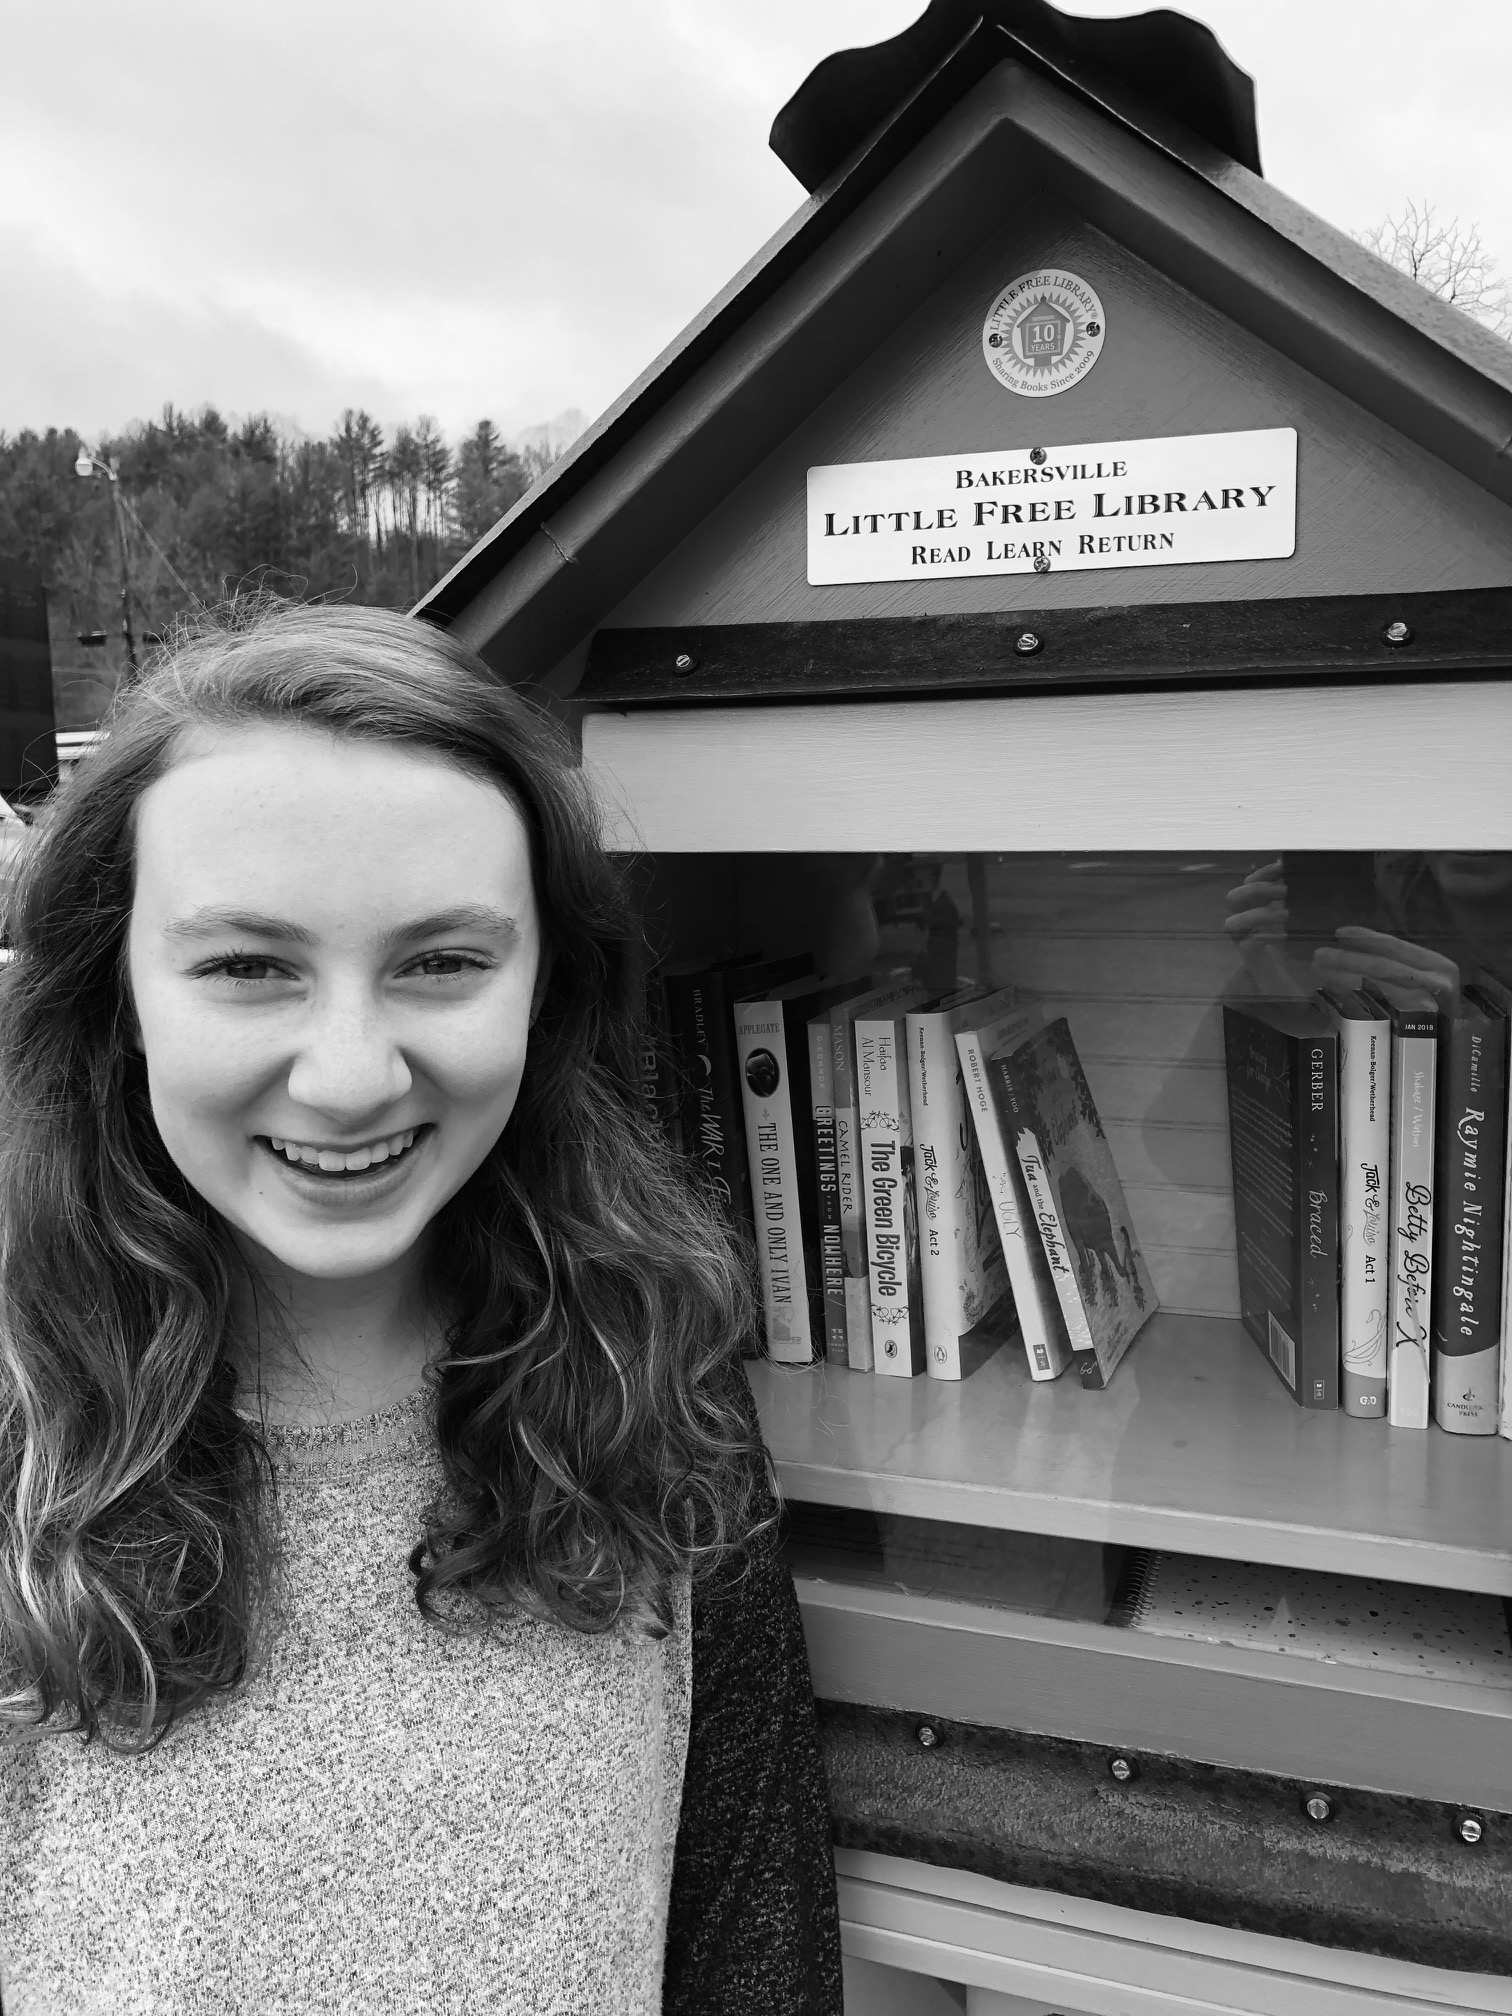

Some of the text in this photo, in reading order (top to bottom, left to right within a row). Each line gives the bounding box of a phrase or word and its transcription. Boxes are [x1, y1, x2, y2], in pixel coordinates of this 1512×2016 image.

[990, 289, 1018, 331] LITTLE
[1018, 276, 1051, 293] FREE
[1031, 342, 1055, 352] YEARS
[1033, 324, 1055, 343] 10
[992, 350, 1095, 392] Sharing Books Since 2009
[955, 460, 1128, 489] BAKERSVILLE
[823, 485, 1276, 537] LITTLE FREE LIBRARY
[911, 532, 1175, 565] READ LEARN RETURN
[692, 989, 706, 1045] BRADLEY
[738, 1022, 780, 1036] APPLEGATE
[1404, 1023, 1416, 1031] JAN
[832, 1024, 846, 1072] MASON
[861, 1036, 875, 1096] Al Mansour
[878, 1036, 892, 1071] Haifaa
[1470, 1035, 1482, 1093] DiCamillo
[967, 1049, 989, 1112] ROBERT HOGE
[1001, 1064, 1014, 1092] HARRIS
[1010, 1097, 1020, 1113] YOO
[1311, 1048, 1324, 1112] GERBER
[1413, 1071, 1424, 1103] Shabazz
[698, 1086, 715, 1116] The
[699, 1116, 725, 1158] WAR
[814, 1105, 837, 1192] GREETINGS
[1412, 1112, 1424, 1148] Watson
[706, 1160, 722, 1171] I
[838, 1120, 853, 1214] CAMEL RIDER
[919, 1143, 935, 1172] Jack
[1360, 1162, 1381, 1193] Jack
[924, 1171, 940, 1192] &
[757, 1122, 792, 1303] THE ONE AND ONLY IVAN
[870, 1140, 903, 1297] The Green Bicycle
[924, 1184, 938, 1221] Louisa
[999, 1200, 1022, 1239] UGLY
[1021, 1155, 1070, 1274] Tua and the Elephant
[1365, 1192, 1380, 1212] &
[1397, 1181, 1432, 1243] Betty
[1452, 1106, 1485, 1336] Raymie Nightingale
[929, 1229, 939, 1247] Act
[1309, 1189, 1328, 1259] Braced
[1362, 1209, 1381, 1246] Louisa
[823, 1224, 844, 1296] NOWHERE
[1365, 1254, 1376, 1274] Act
